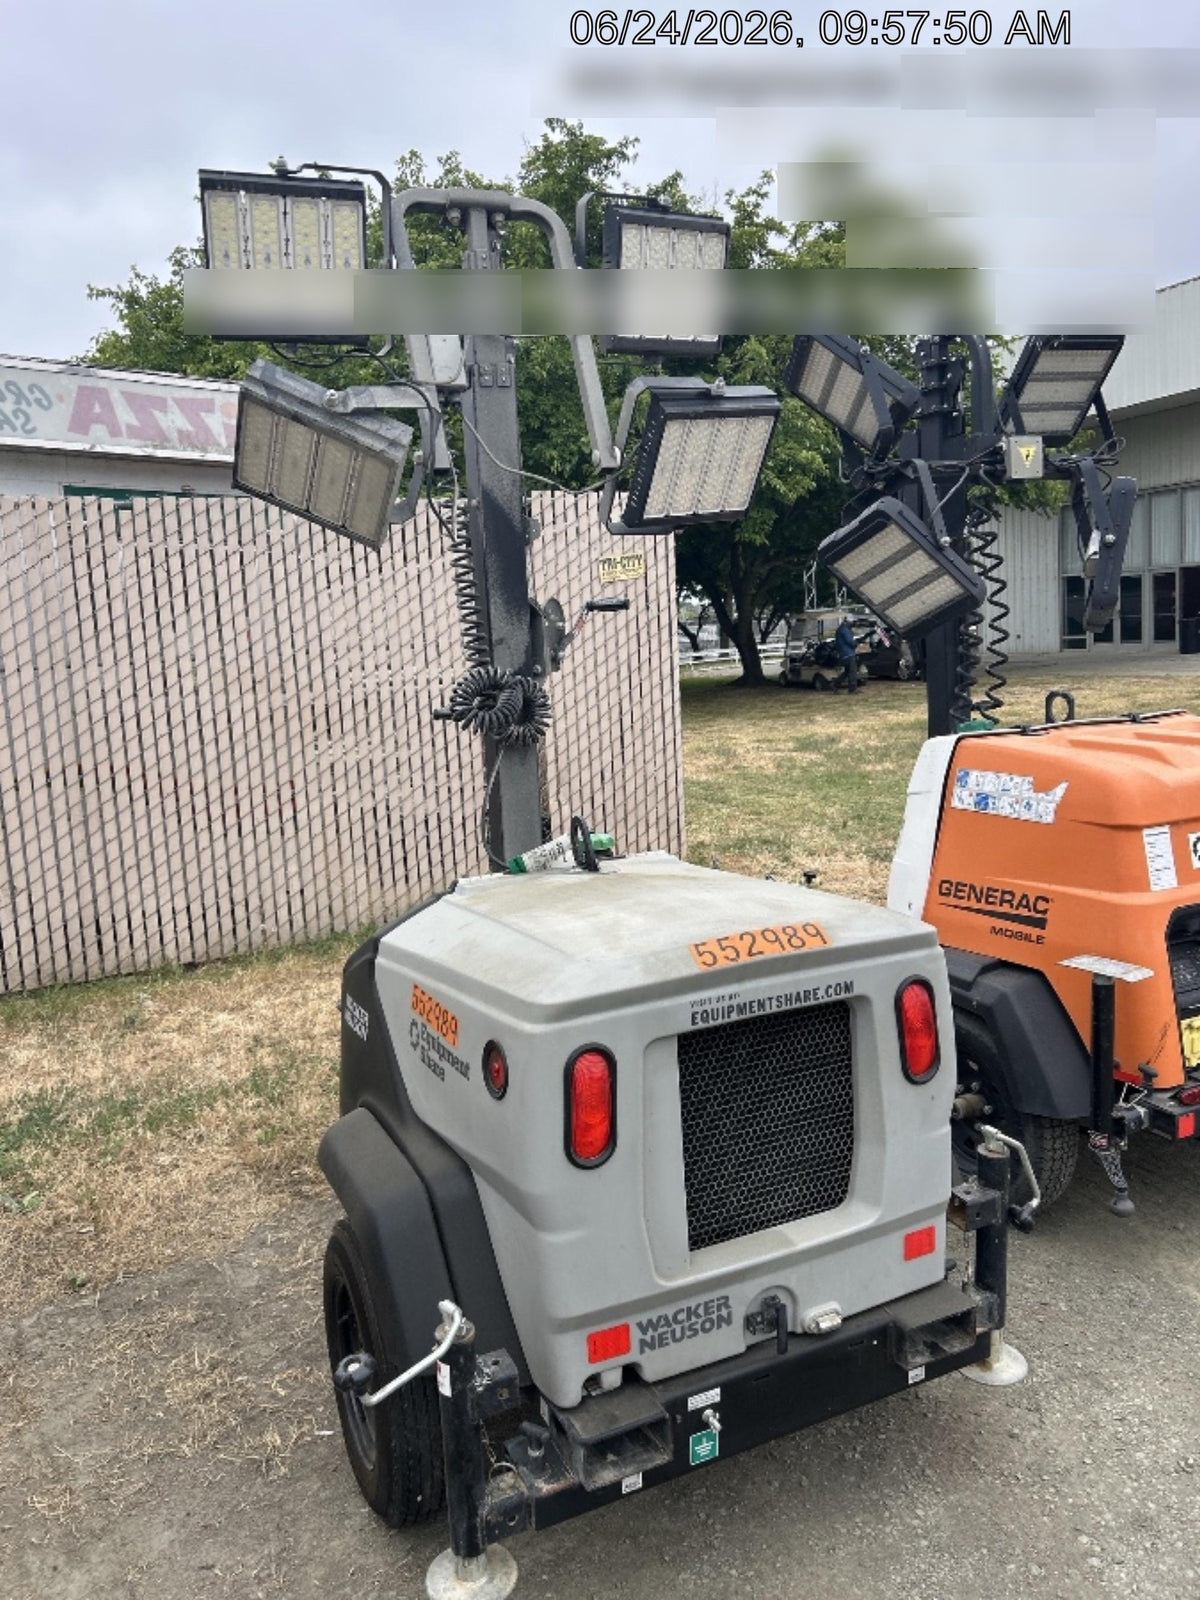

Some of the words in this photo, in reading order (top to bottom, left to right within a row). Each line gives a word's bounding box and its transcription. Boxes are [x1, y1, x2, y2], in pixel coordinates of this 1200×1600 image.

[938, 878, 1050, 915] GENERAC
[693, 922, 829, 968] 552989
[989, 925, 1046, 945] MOBILE
[411, 984, 458, 1047] 552989
[690, 980, 855, 1027] EQUIPMENTSHARE.COM
[635, 1295, 733, 1336] WACKER
[638, 1310, 733, 1356] NEUSON
